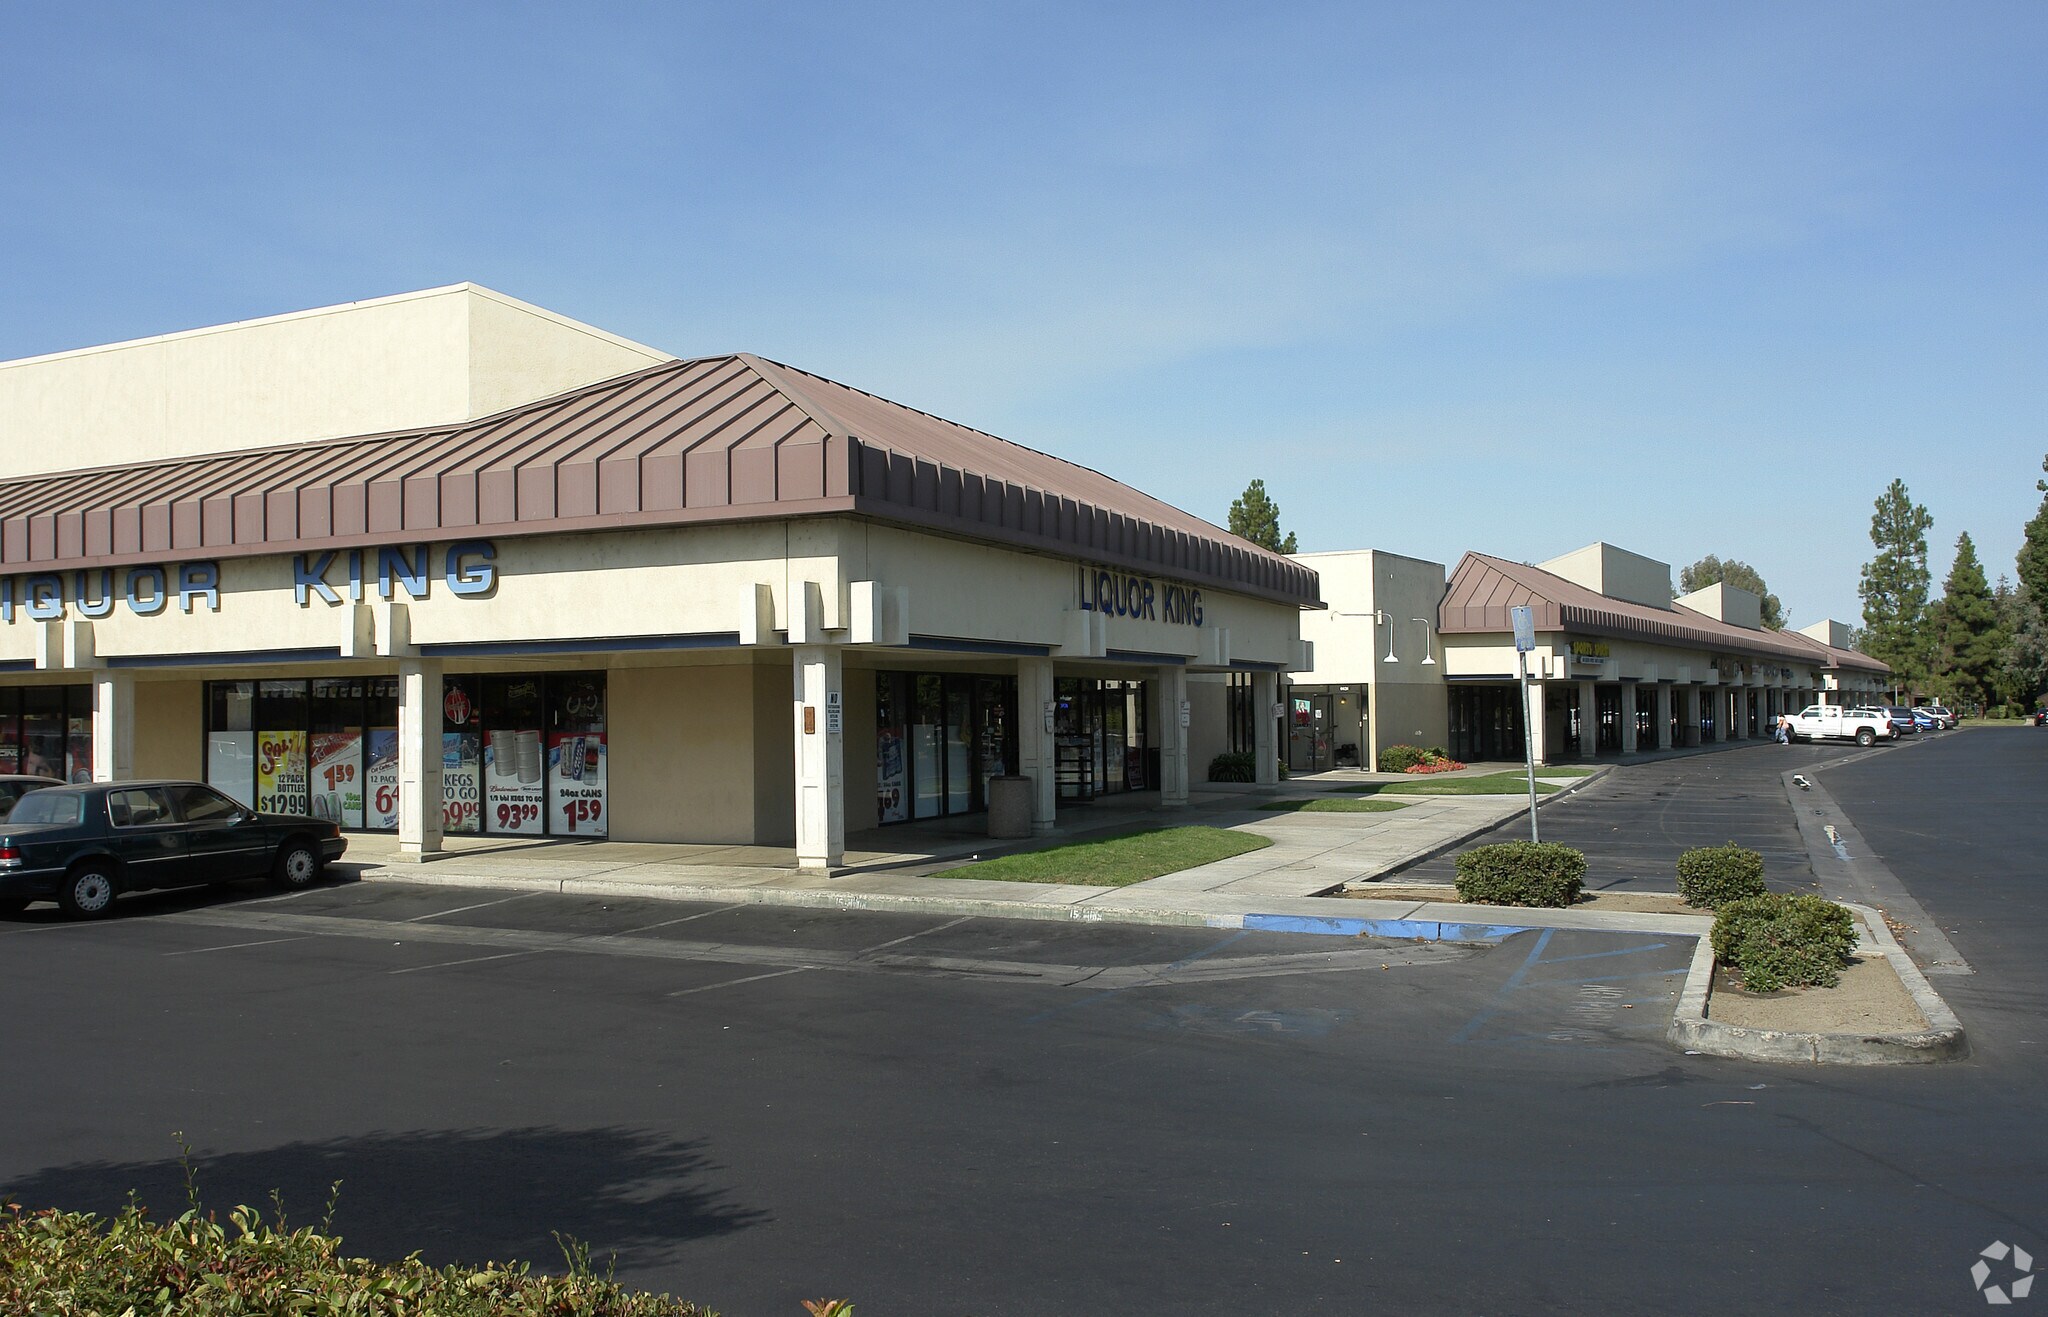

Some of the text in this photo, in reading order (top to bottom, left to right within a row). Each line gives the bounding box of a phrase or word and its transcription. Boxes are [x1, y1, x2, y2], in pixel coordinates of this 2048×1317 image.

[293, 541, 499, 607] KING
[1079, 566, 1203, 628] LIQUOR KING
[278, 774, 305, 784] 12 PACK
[380, 775, 397, 783] PACK
[444, 773, 474, 787] KEGS
[277, 784, 305, 793] BOTTLES
[443, 786, 478, 801] O GO
[580, 788, 602, 798] CANS
[525, 795, 533, 803] TO
[563, 799, 602, 833] 159
